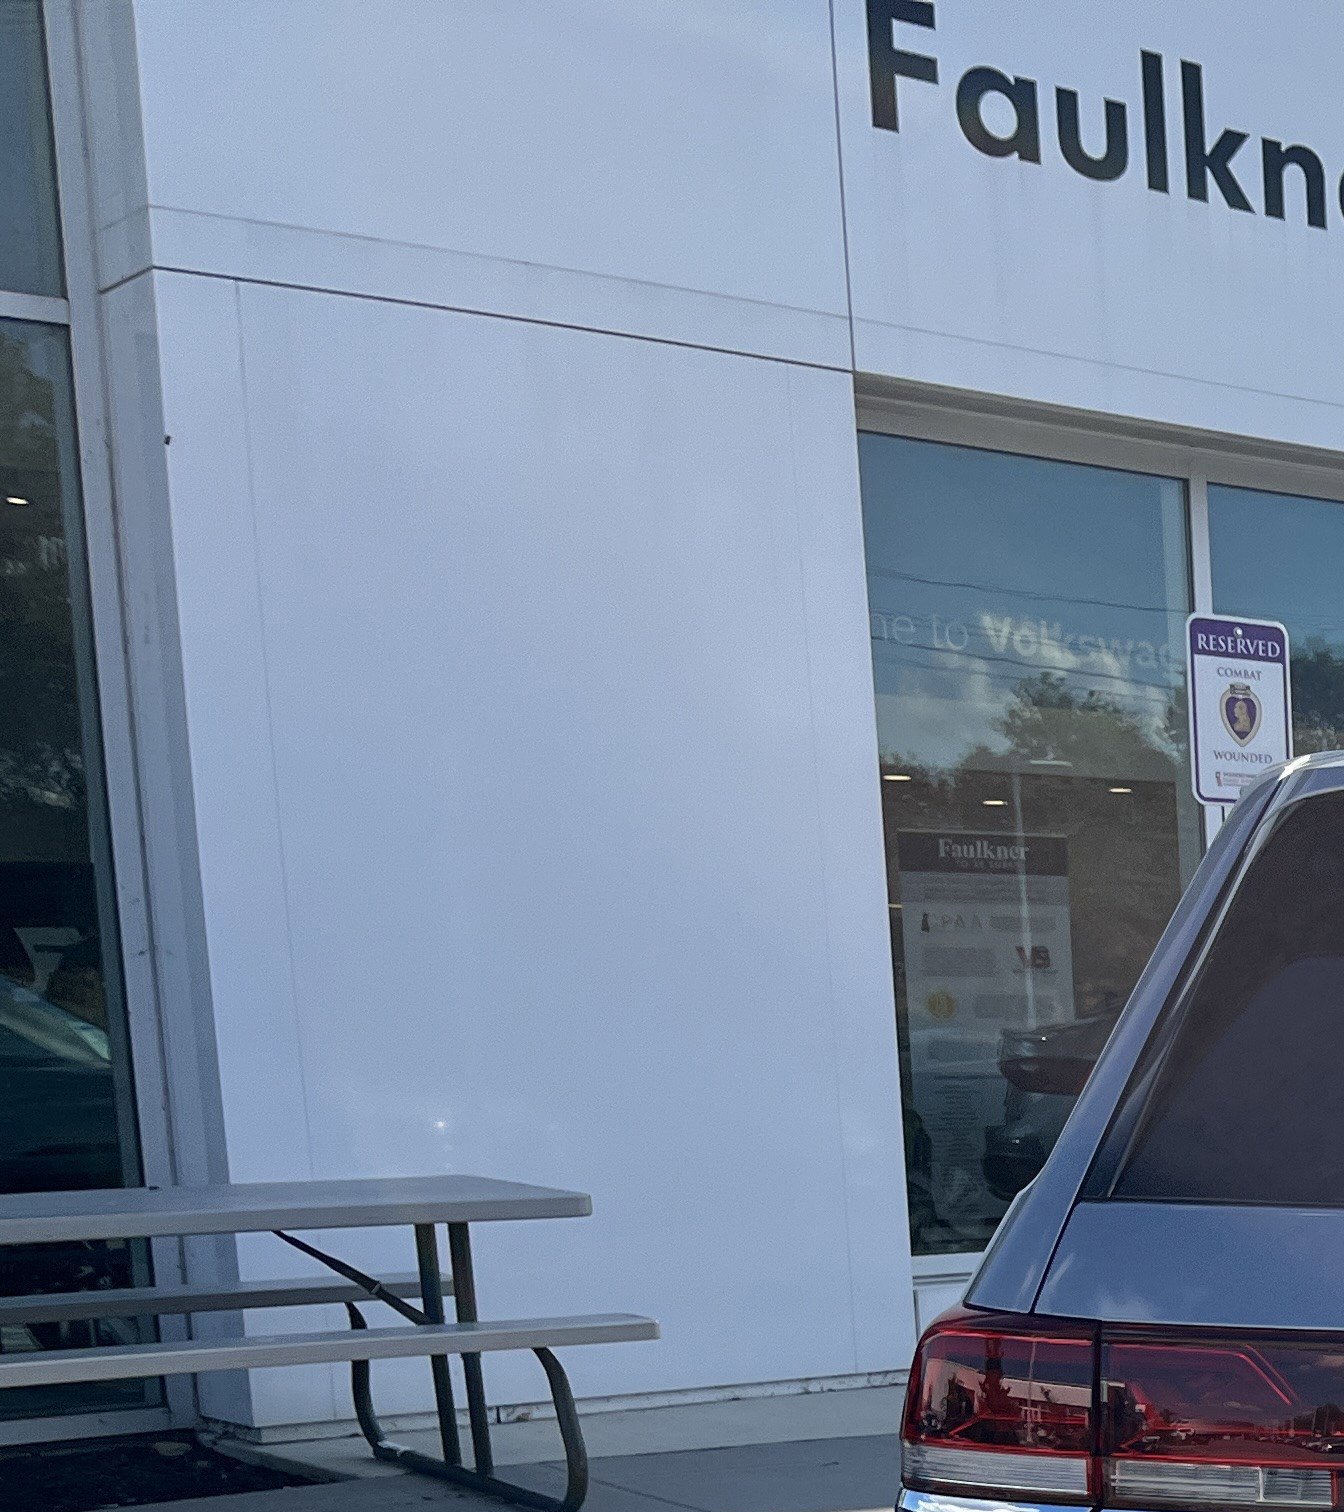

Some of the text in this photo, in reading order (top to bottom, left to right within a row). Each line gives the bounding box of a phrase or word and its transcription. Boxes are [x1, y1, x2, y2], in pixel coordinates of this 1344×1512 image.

[1197, 633, 1281, 658] RESERVED
[1216, 666, 1262, 681] COMBAT
[1213, 750, 1273, 764] WOUNDED
[938, 839, 1030, 860] Faulkner
